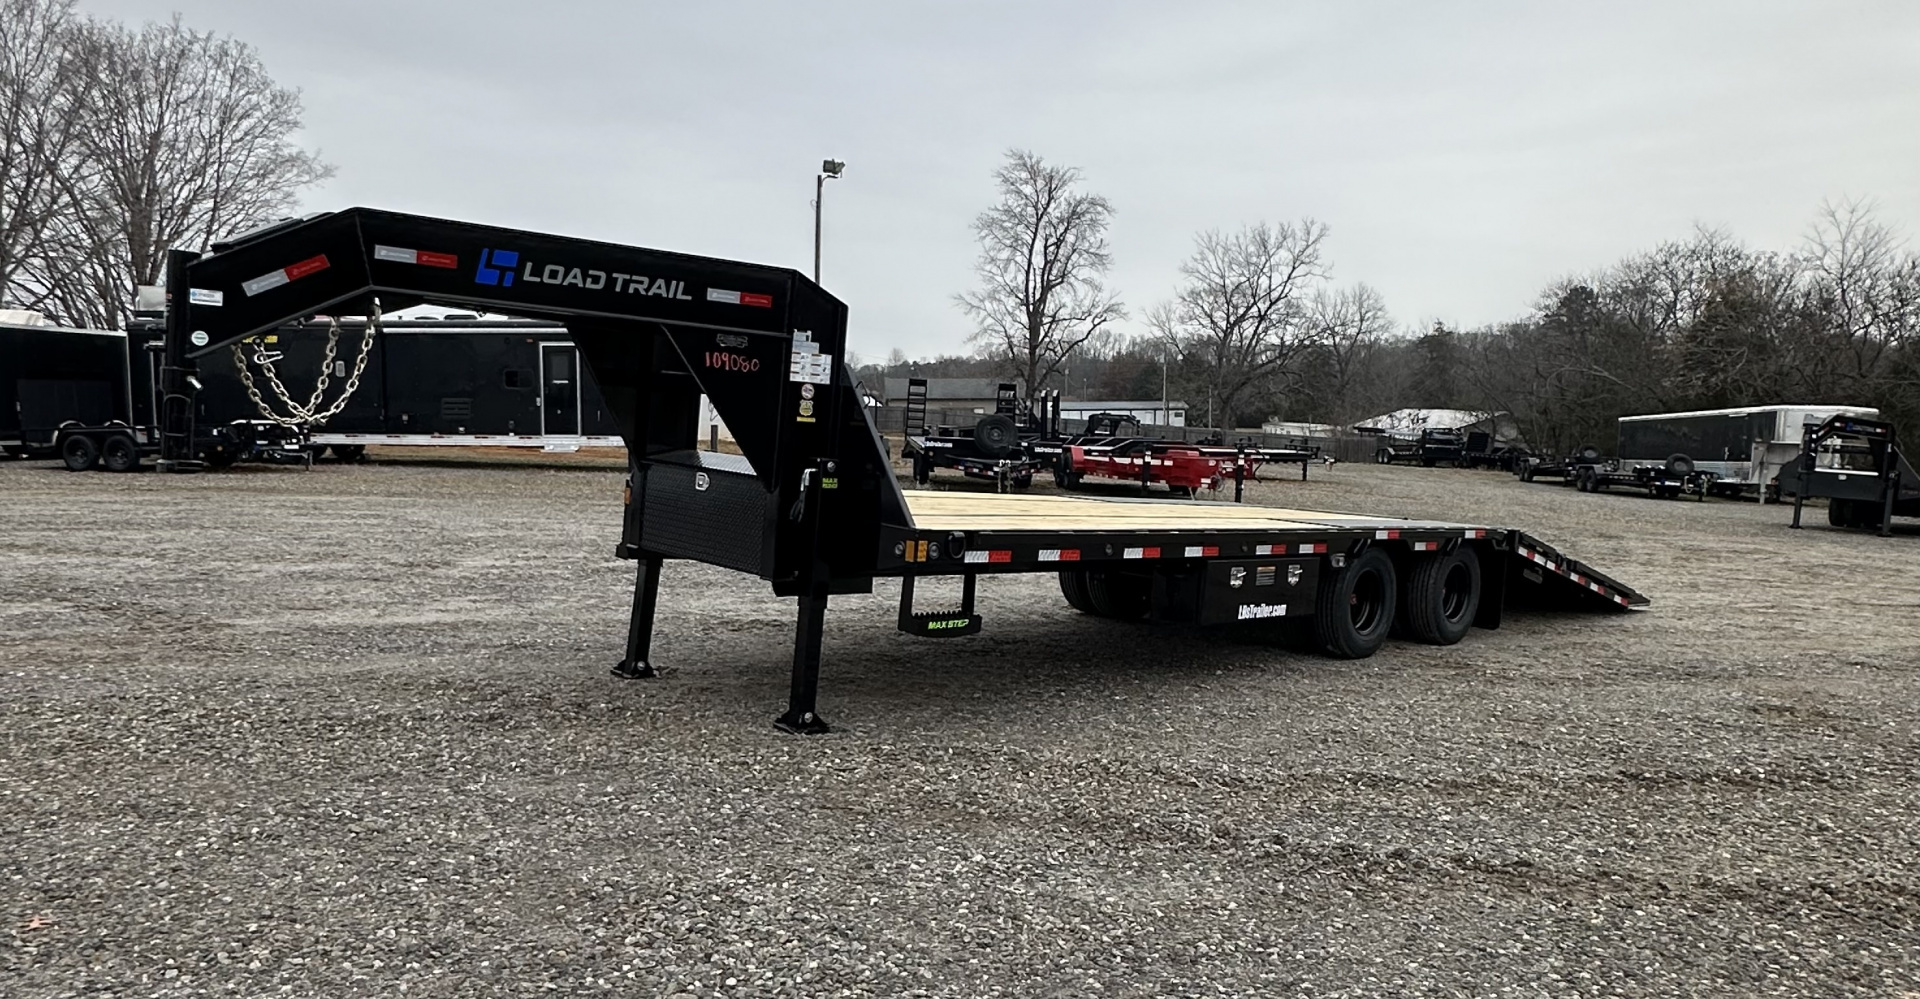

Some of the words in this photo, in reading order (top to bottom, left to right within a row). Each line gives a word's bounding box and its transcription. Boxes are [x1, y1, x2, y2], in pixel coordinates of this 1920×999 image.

[522, 261, 607, 290] LOAD
[612, 272, 693, 301] TRAIL
[705, 351, 760, 372] 109080
[928, 621, 947, 630] MAX
[947, 618, 969, 629] STEP
